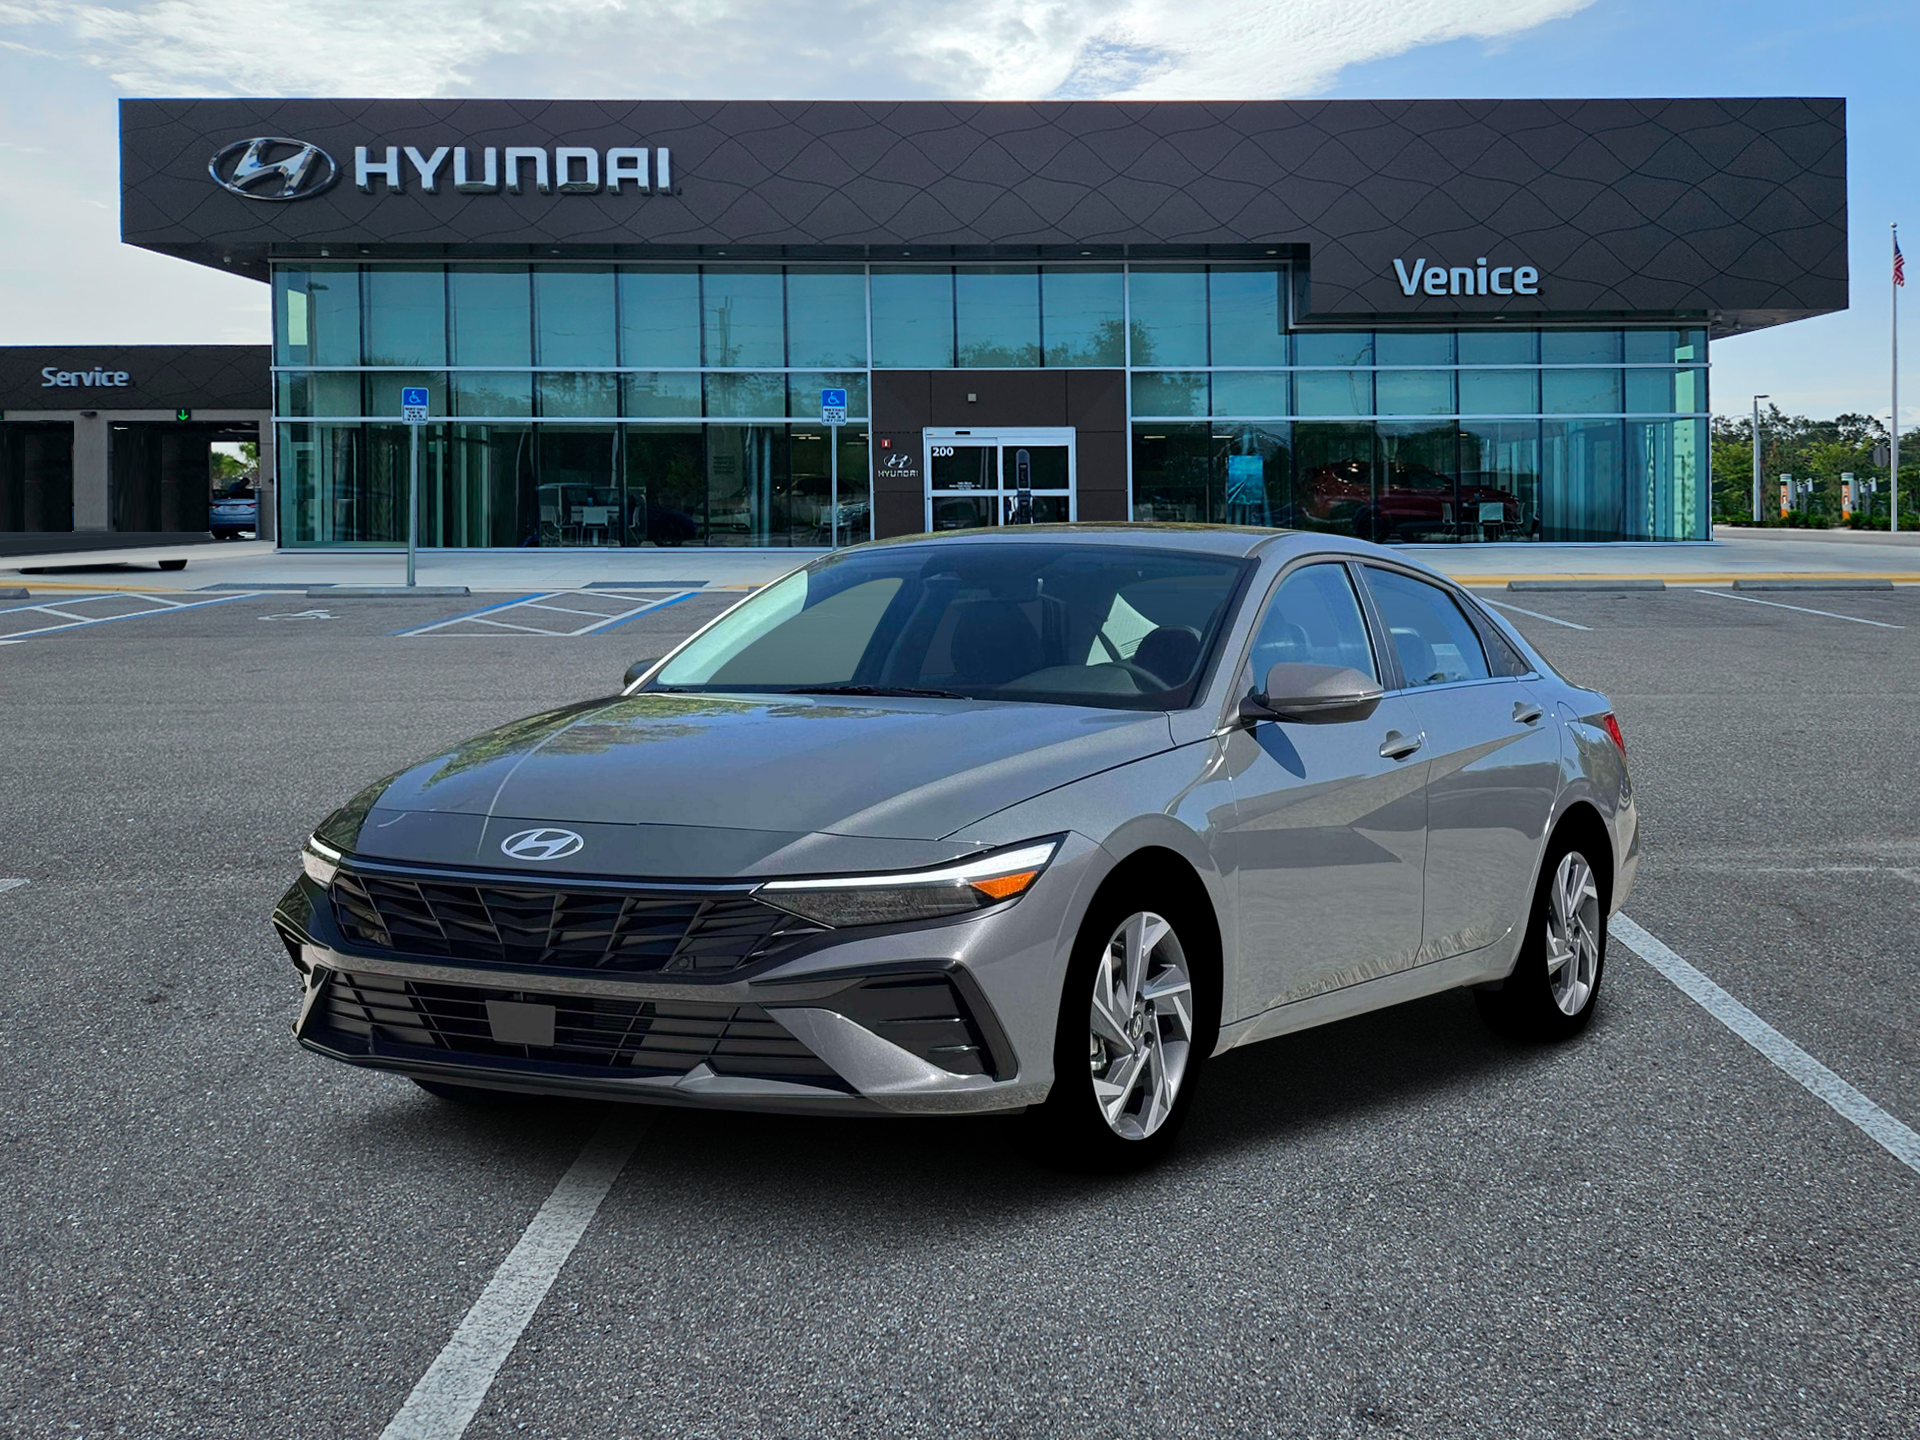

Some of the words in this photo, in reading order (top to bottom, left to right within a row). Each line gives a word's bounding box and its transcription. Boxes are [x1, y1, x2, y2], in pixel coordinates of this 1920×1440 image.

[354, 146, 671, 194] HYUNDAI
[1392, 257, 1539, 296] Venice
[41, 366, 130, 387] Service
[932, 446, 954, 457] 200
[877, 469, 919, 478] HYUNDAI
